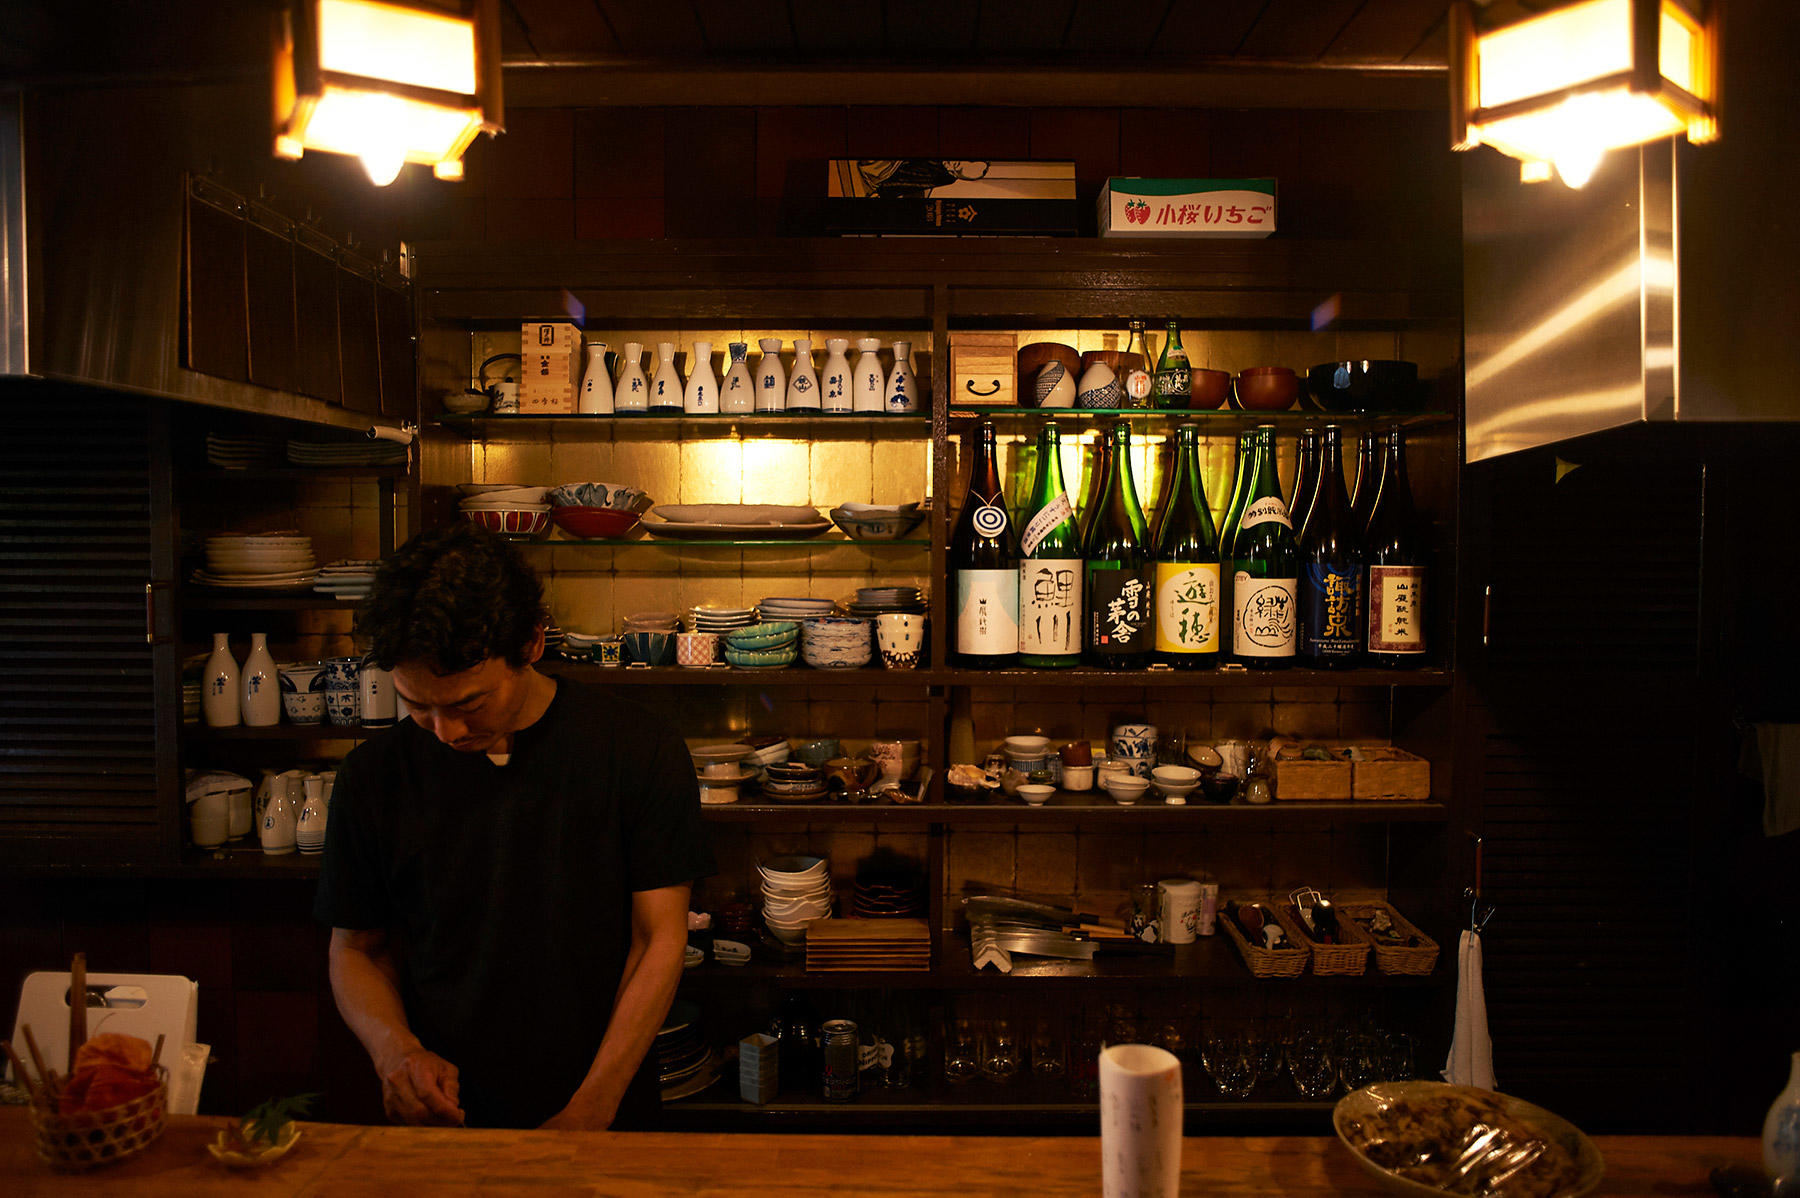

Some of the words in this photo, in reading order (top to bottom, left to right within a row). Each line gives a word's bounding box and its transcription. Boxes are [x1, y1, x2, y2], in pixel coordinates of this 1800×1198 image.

[1155, 203, 1272, 225] 小桜いちご
[1032, 568, 1074, 651] 鯉川
[1106, 578, 1144, 643] 雪の茅舎
[1323, 573, 1355, 637] 諏訪泉
